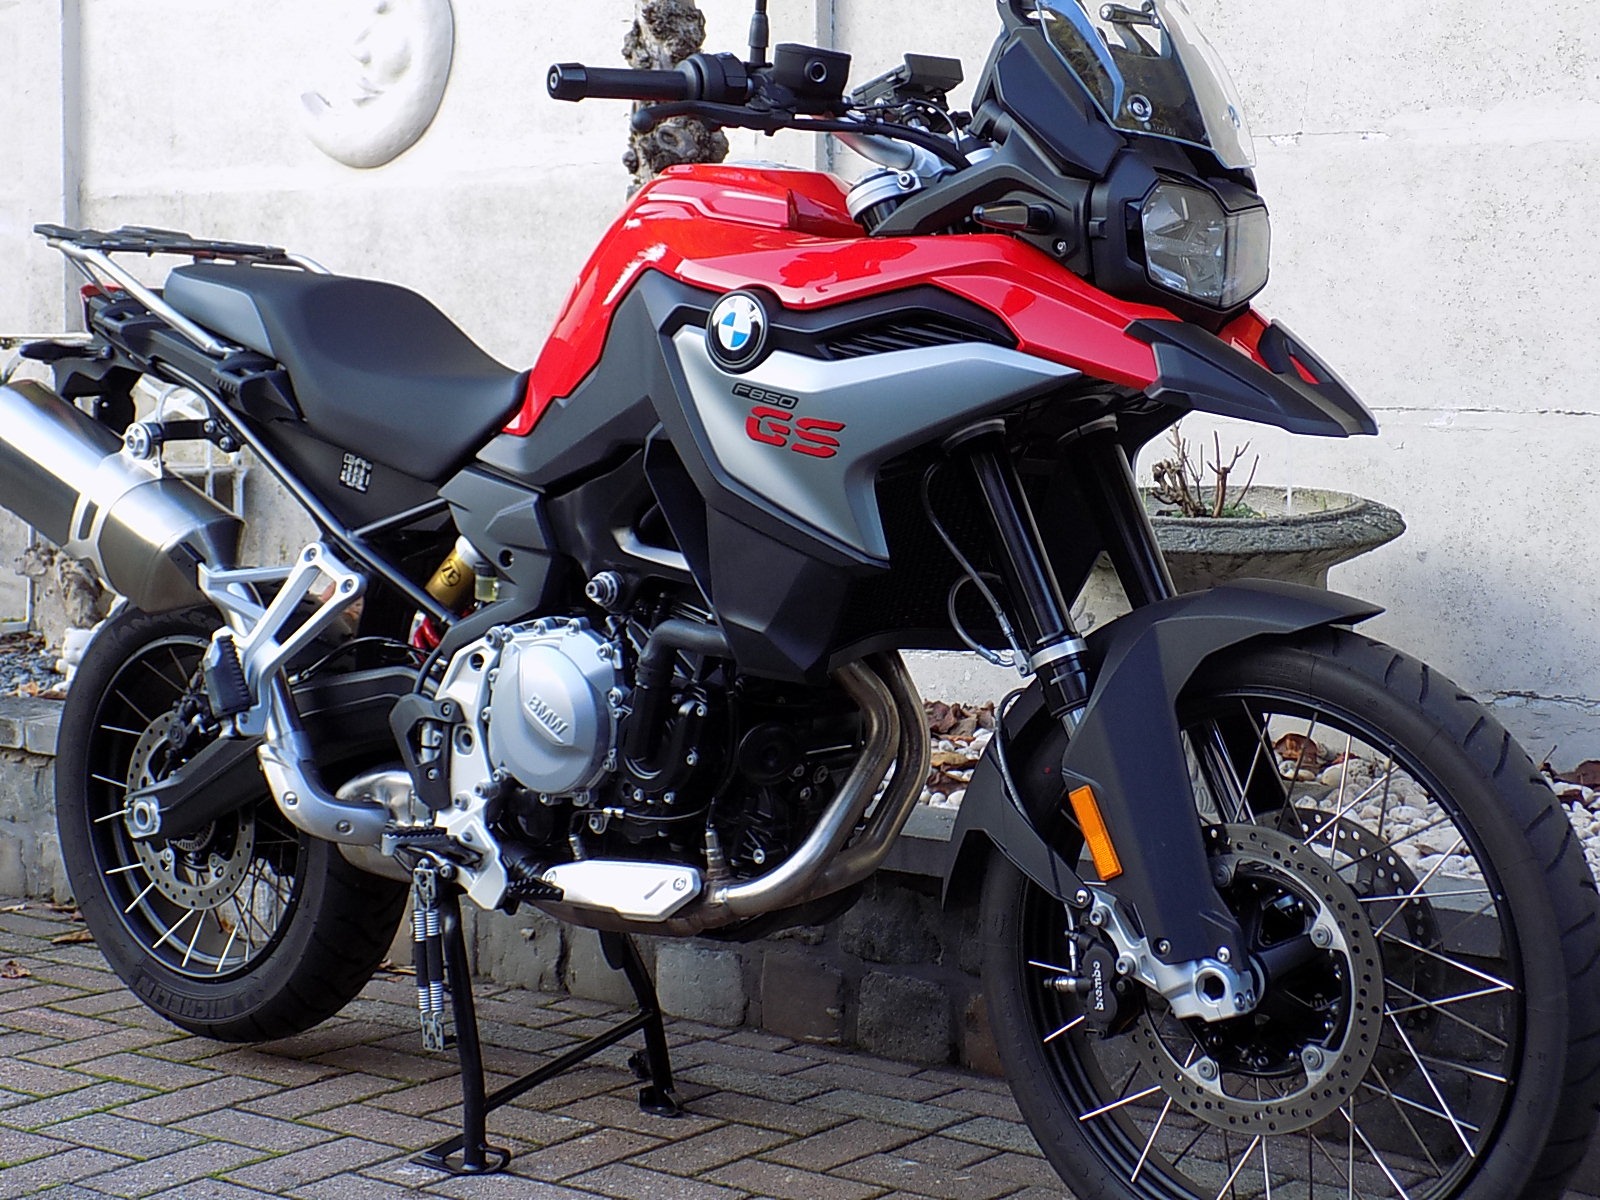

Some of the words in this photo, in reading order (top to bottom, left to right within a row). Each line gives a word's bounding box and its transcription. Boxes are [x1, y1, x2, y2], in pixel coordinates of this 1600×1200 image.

[734, 384, 798, 408] F850
[745, 405, 846, 458] GS
[528, 692, 568, 735] BMW
[135, 976, 235, 1018] MICHELIN
[1091, 960, 1104, 1010] brembo
